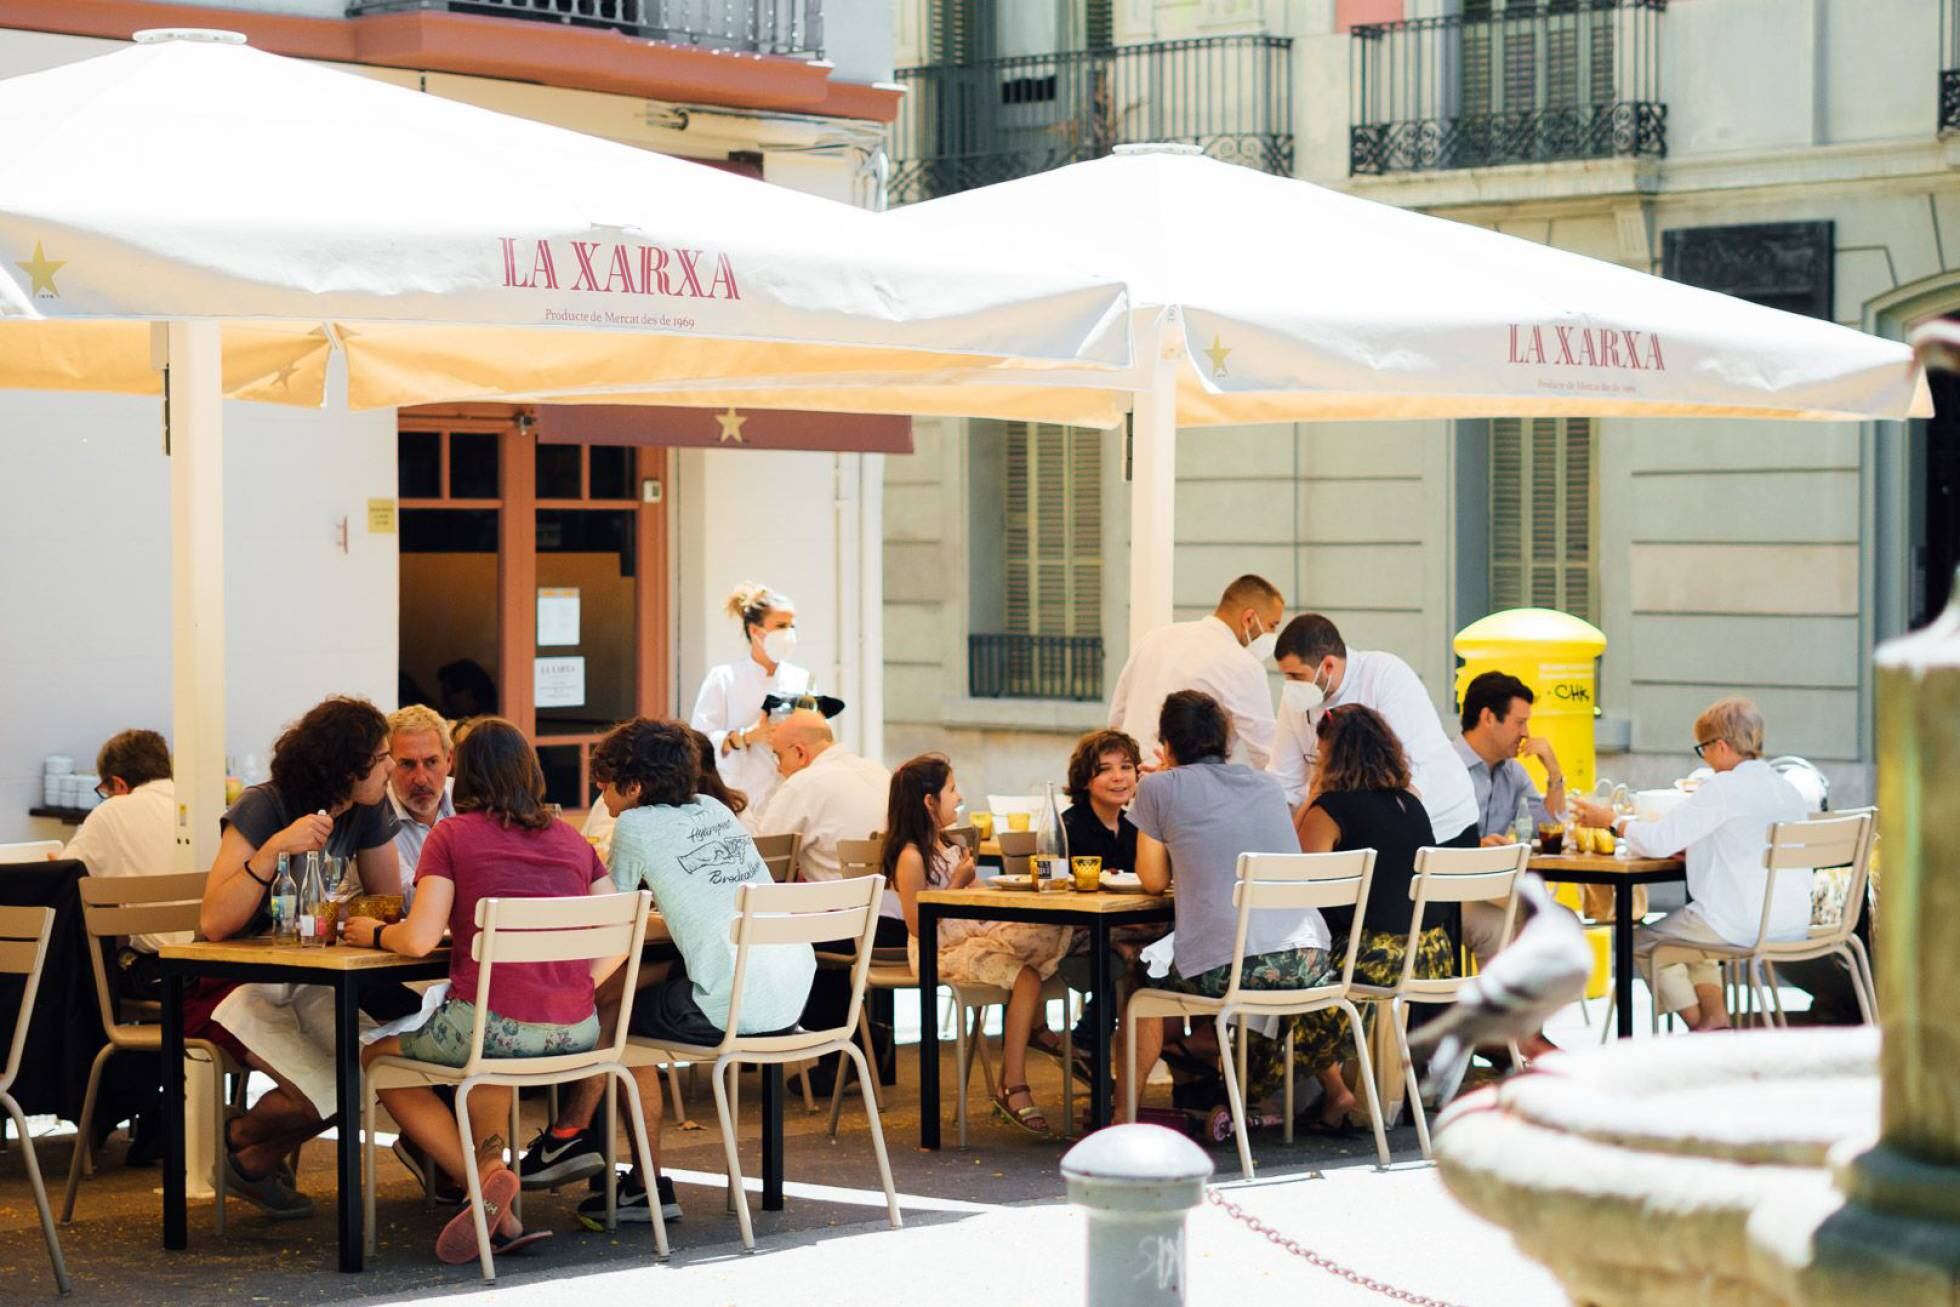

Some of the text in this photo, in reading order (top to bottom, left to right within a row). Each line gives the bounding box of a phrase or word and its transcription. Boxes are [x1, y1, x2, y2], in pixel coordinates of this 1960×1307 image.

[498, 237, 742, 300] LA XARXA
[545, 308, 590, 321] Producte
[591, 311, 602, 322] de
[605, 311, 639, 324] Mercat
[659, 314, 672, 326] de
[673, 317, 695, 329] 1969
[1507, 323, 1666, 371] LA XARXA
